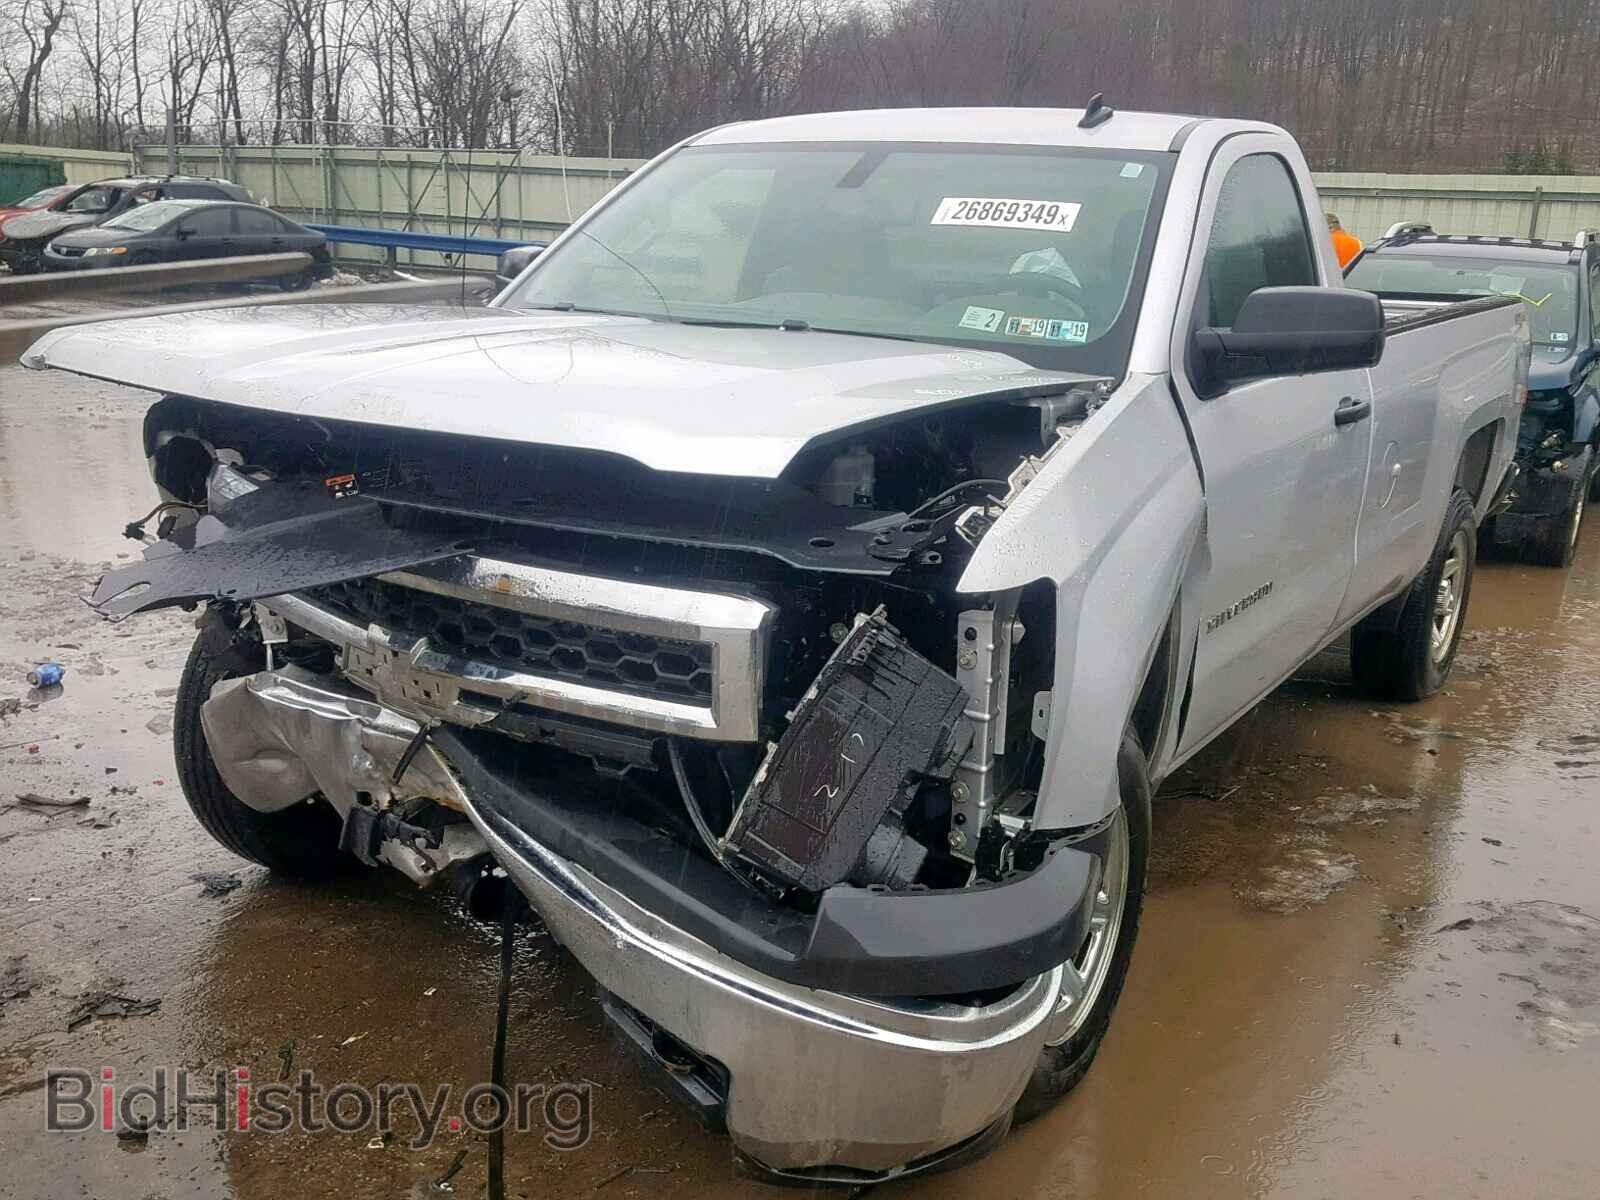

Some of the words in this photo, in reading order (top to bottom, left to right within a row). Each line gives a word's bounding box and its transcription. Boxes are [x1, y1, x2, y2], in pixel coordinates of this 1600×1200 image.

[984, 312, 996, 329] 2
[1032, 319, 1045, 334] 19
[1074, 323, 1086, 338] 19
